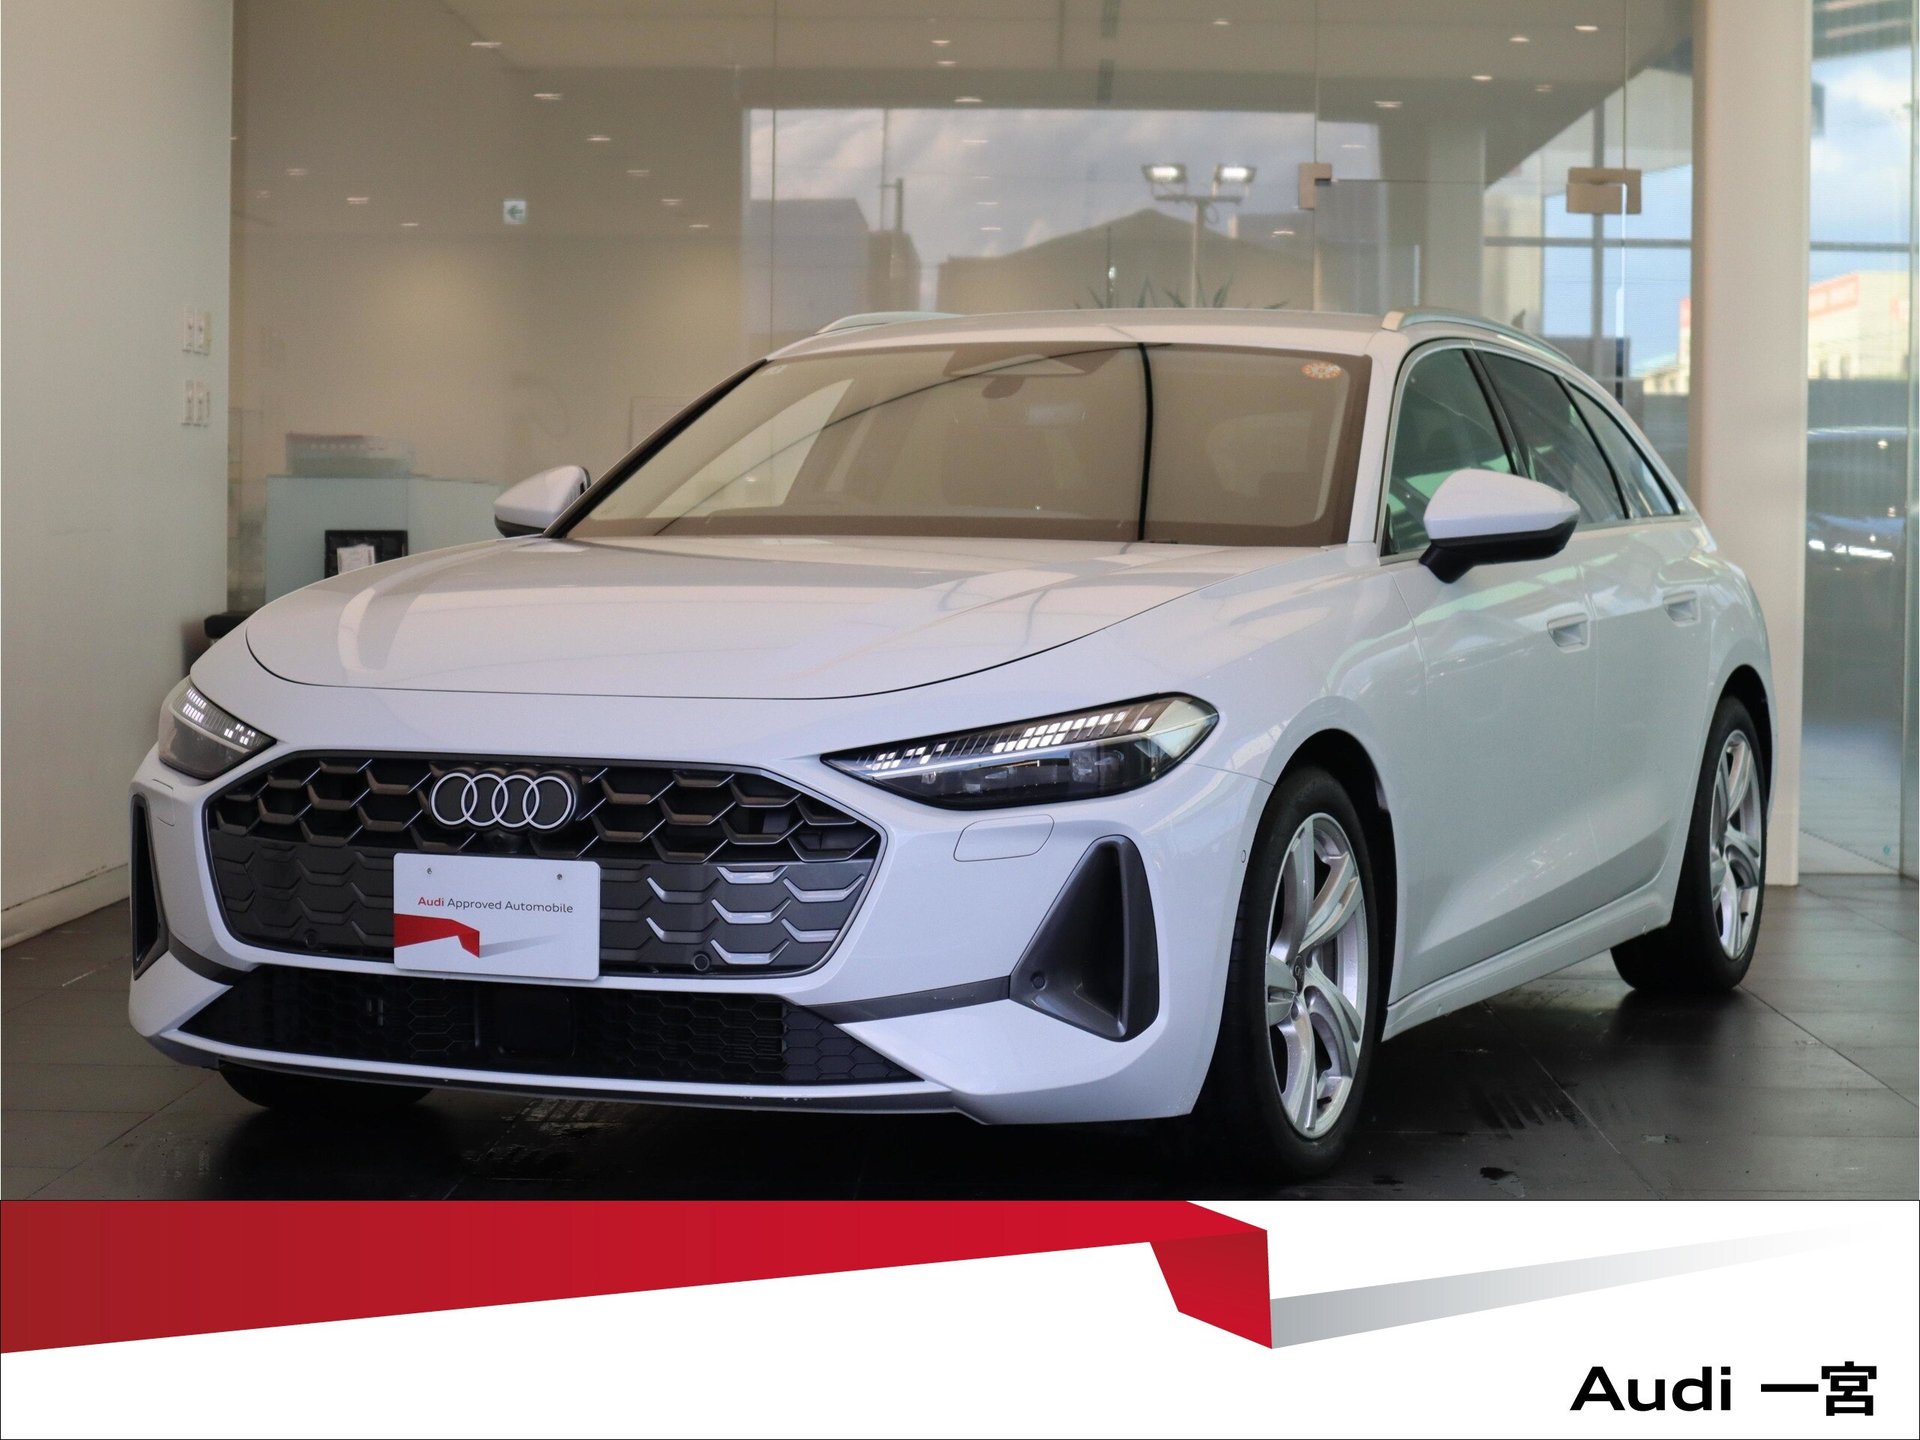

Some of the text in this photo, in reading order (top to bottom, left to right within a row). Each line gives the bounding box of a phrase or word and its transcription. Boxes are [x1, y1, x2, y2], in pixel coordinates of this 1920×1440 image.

[418, 897, 573, 913] Audi Approved Automobile
